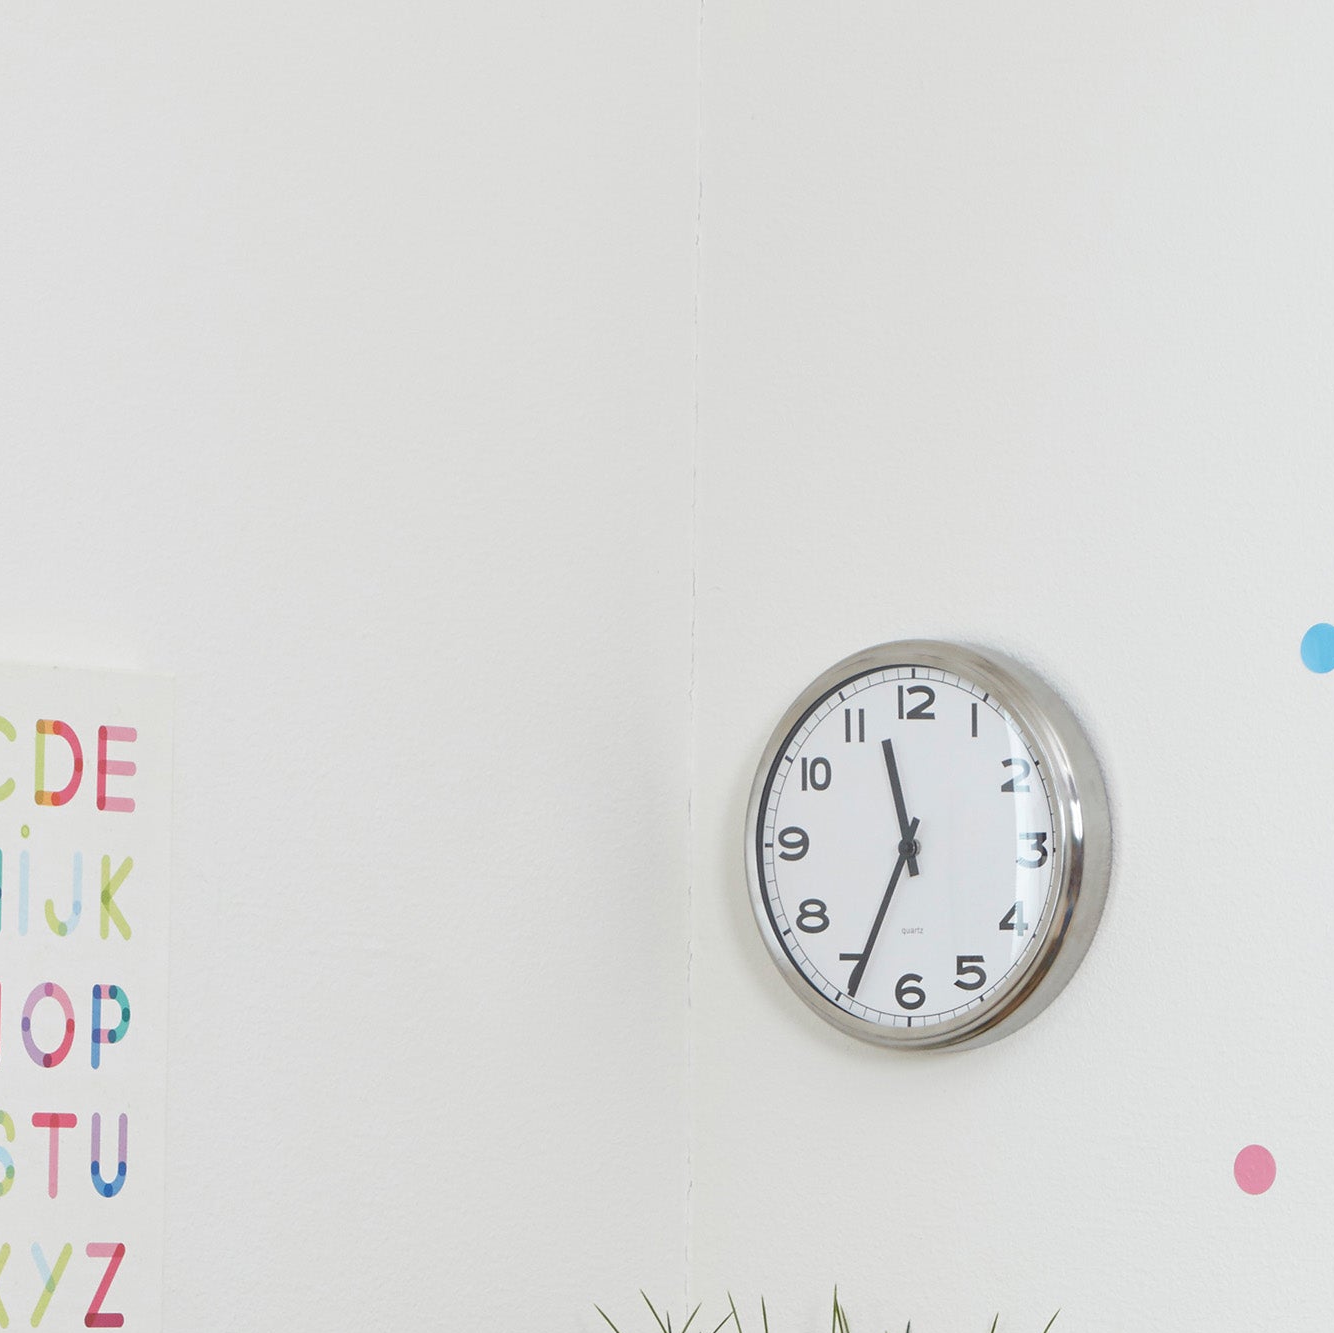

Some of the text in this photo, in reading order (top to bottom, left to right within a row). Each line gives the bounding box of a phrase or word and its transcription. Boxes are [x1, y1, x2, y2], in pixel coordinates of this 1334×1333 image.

[898, 685, 936, 720] 12
[971, 702, 978, 738] 1
[845, 708, 865, 743] 11
[801, 757, 832, 791] 10
[1001, 758, 1032, 793] 2
[778, 826, 809, 862] 9
[1016, 832, 1048, 869] 3
[796, 899, 830, 934] 8
[999, 900, 1029, 937] 4
[954, 955, 987, 991] 5
[895, 973, 926, 1010] 6
